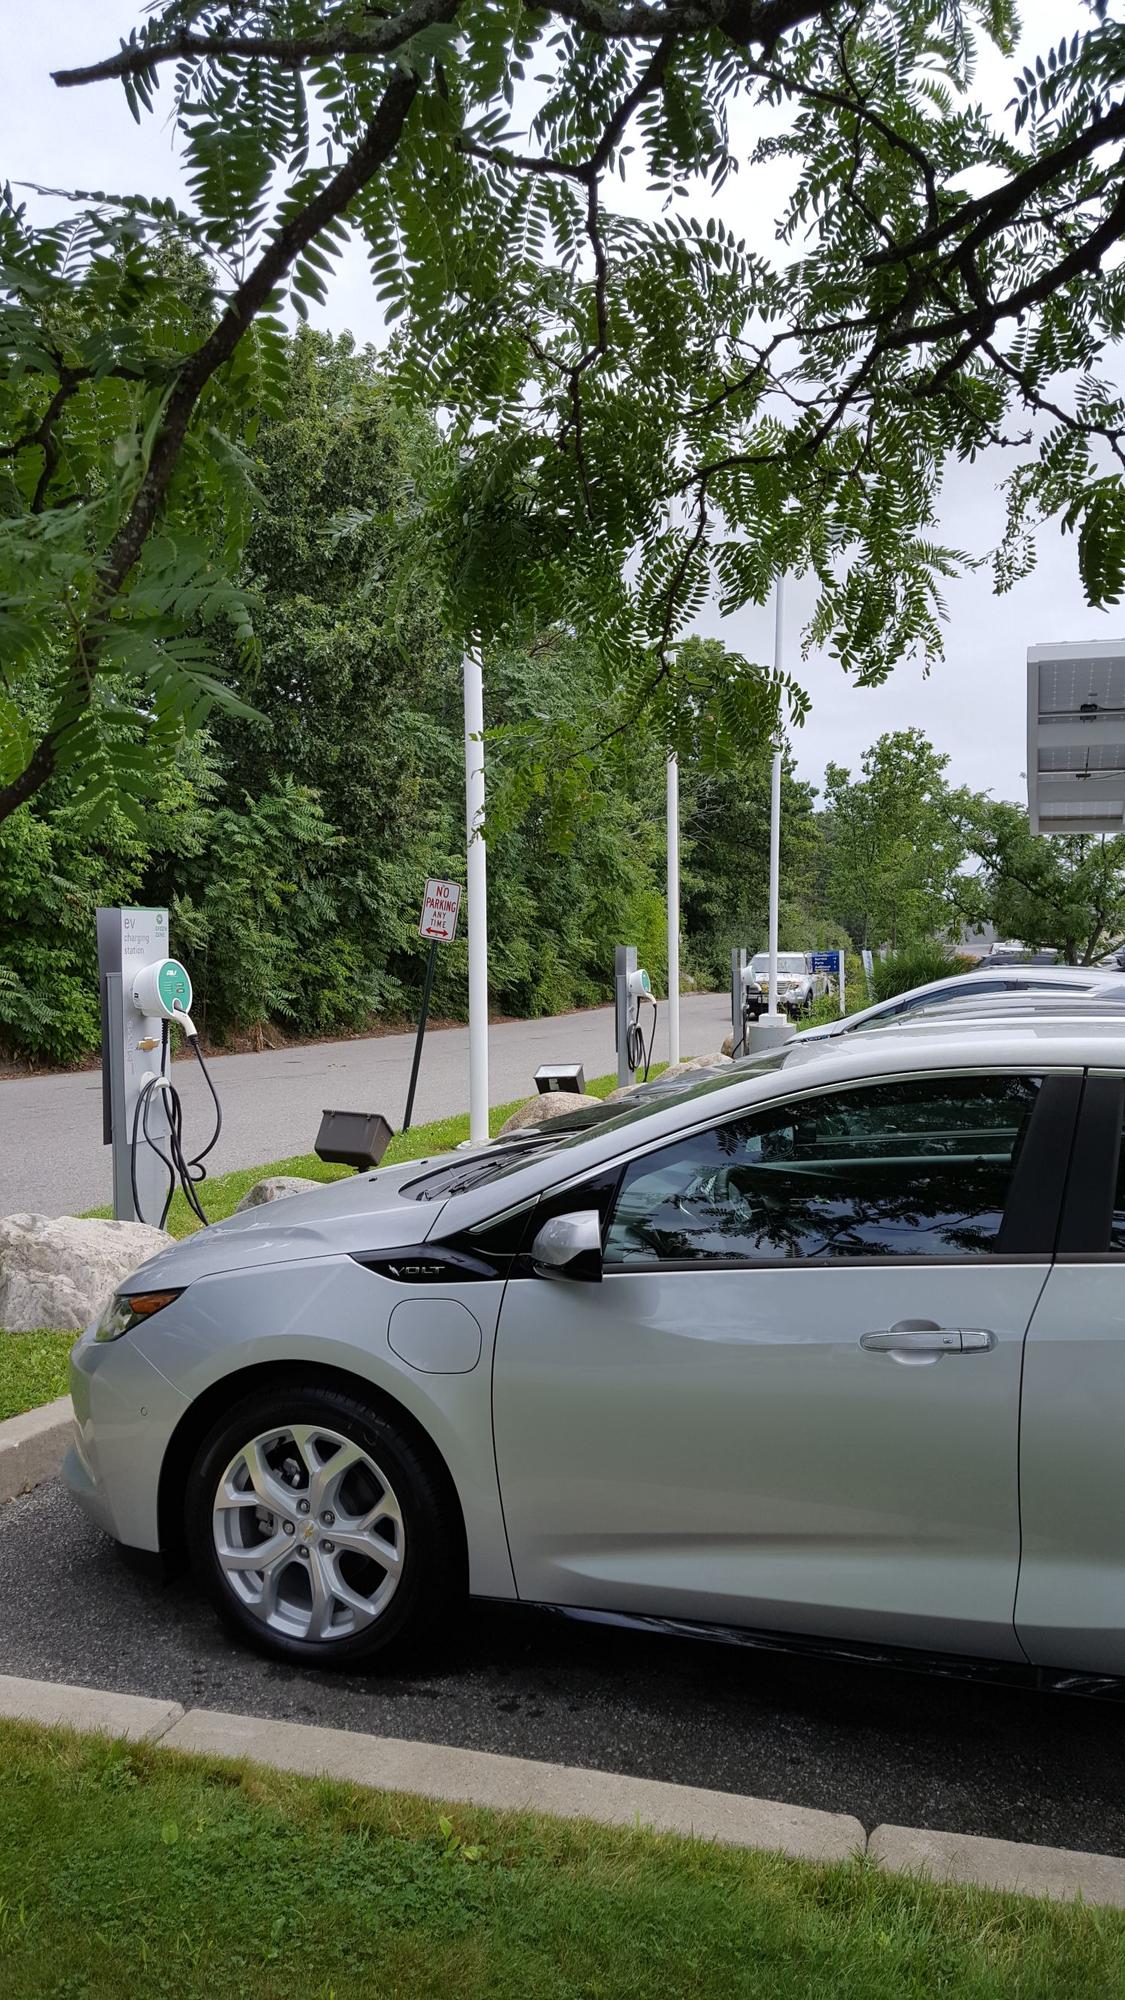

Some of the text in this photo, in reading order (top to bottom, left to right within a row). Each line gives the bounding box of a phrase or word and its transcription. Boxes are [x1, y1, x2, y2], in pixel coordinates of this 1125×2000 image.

[436, 886, 450, 898] NO
[426, 897, 456, 912] PARKING
[433, 911, 446, 919] ANY
[431, 919, 447, 928] TIME
[124, 934, 150, 945] charging
[124, 947, 145, 955] station
[388, 1264, 446, 1277] VOLT
